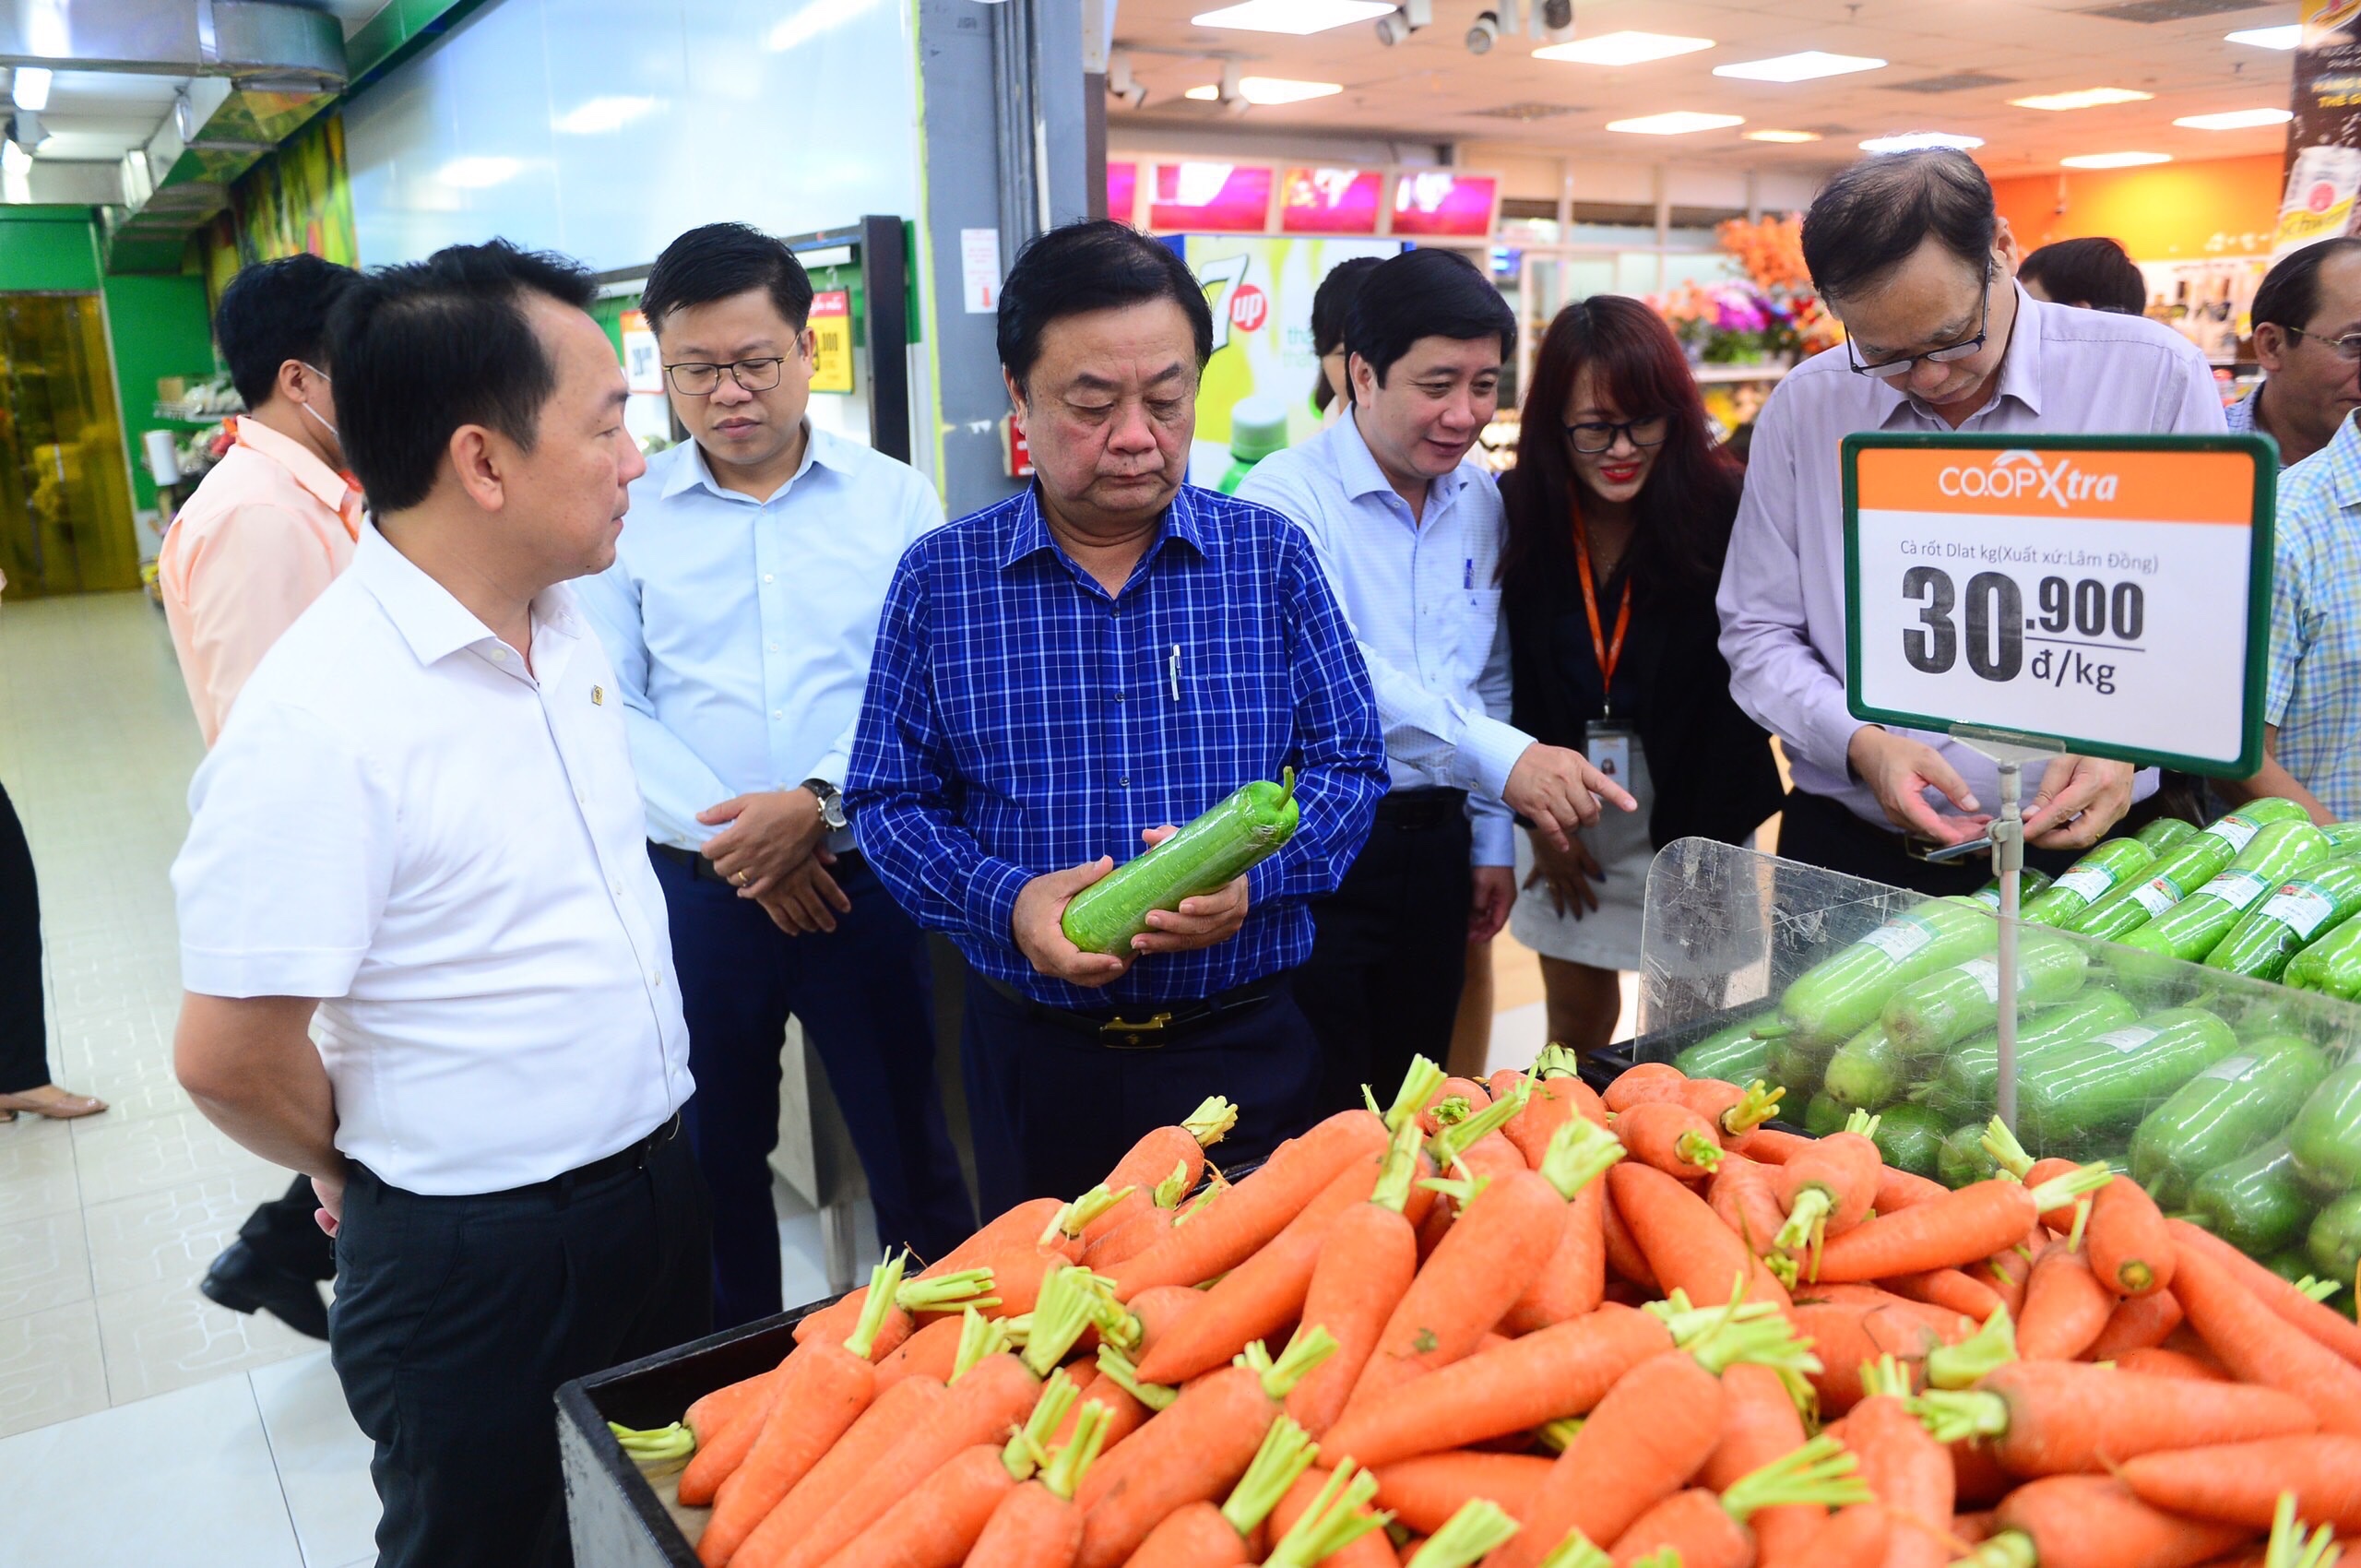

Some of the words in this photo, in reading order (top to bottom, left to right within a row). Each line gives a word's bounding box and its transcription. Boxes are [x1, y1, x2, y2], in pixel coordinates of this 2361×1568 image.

[1901, 540, 1917, 555] Cà
[1921, 540, 1941, 557] rốt
[1946, 542, 1976, 559] Dlat
[2107, 550, 2160, 574] Đồng)
[2031, 647, 2116, 695] đ/kg
